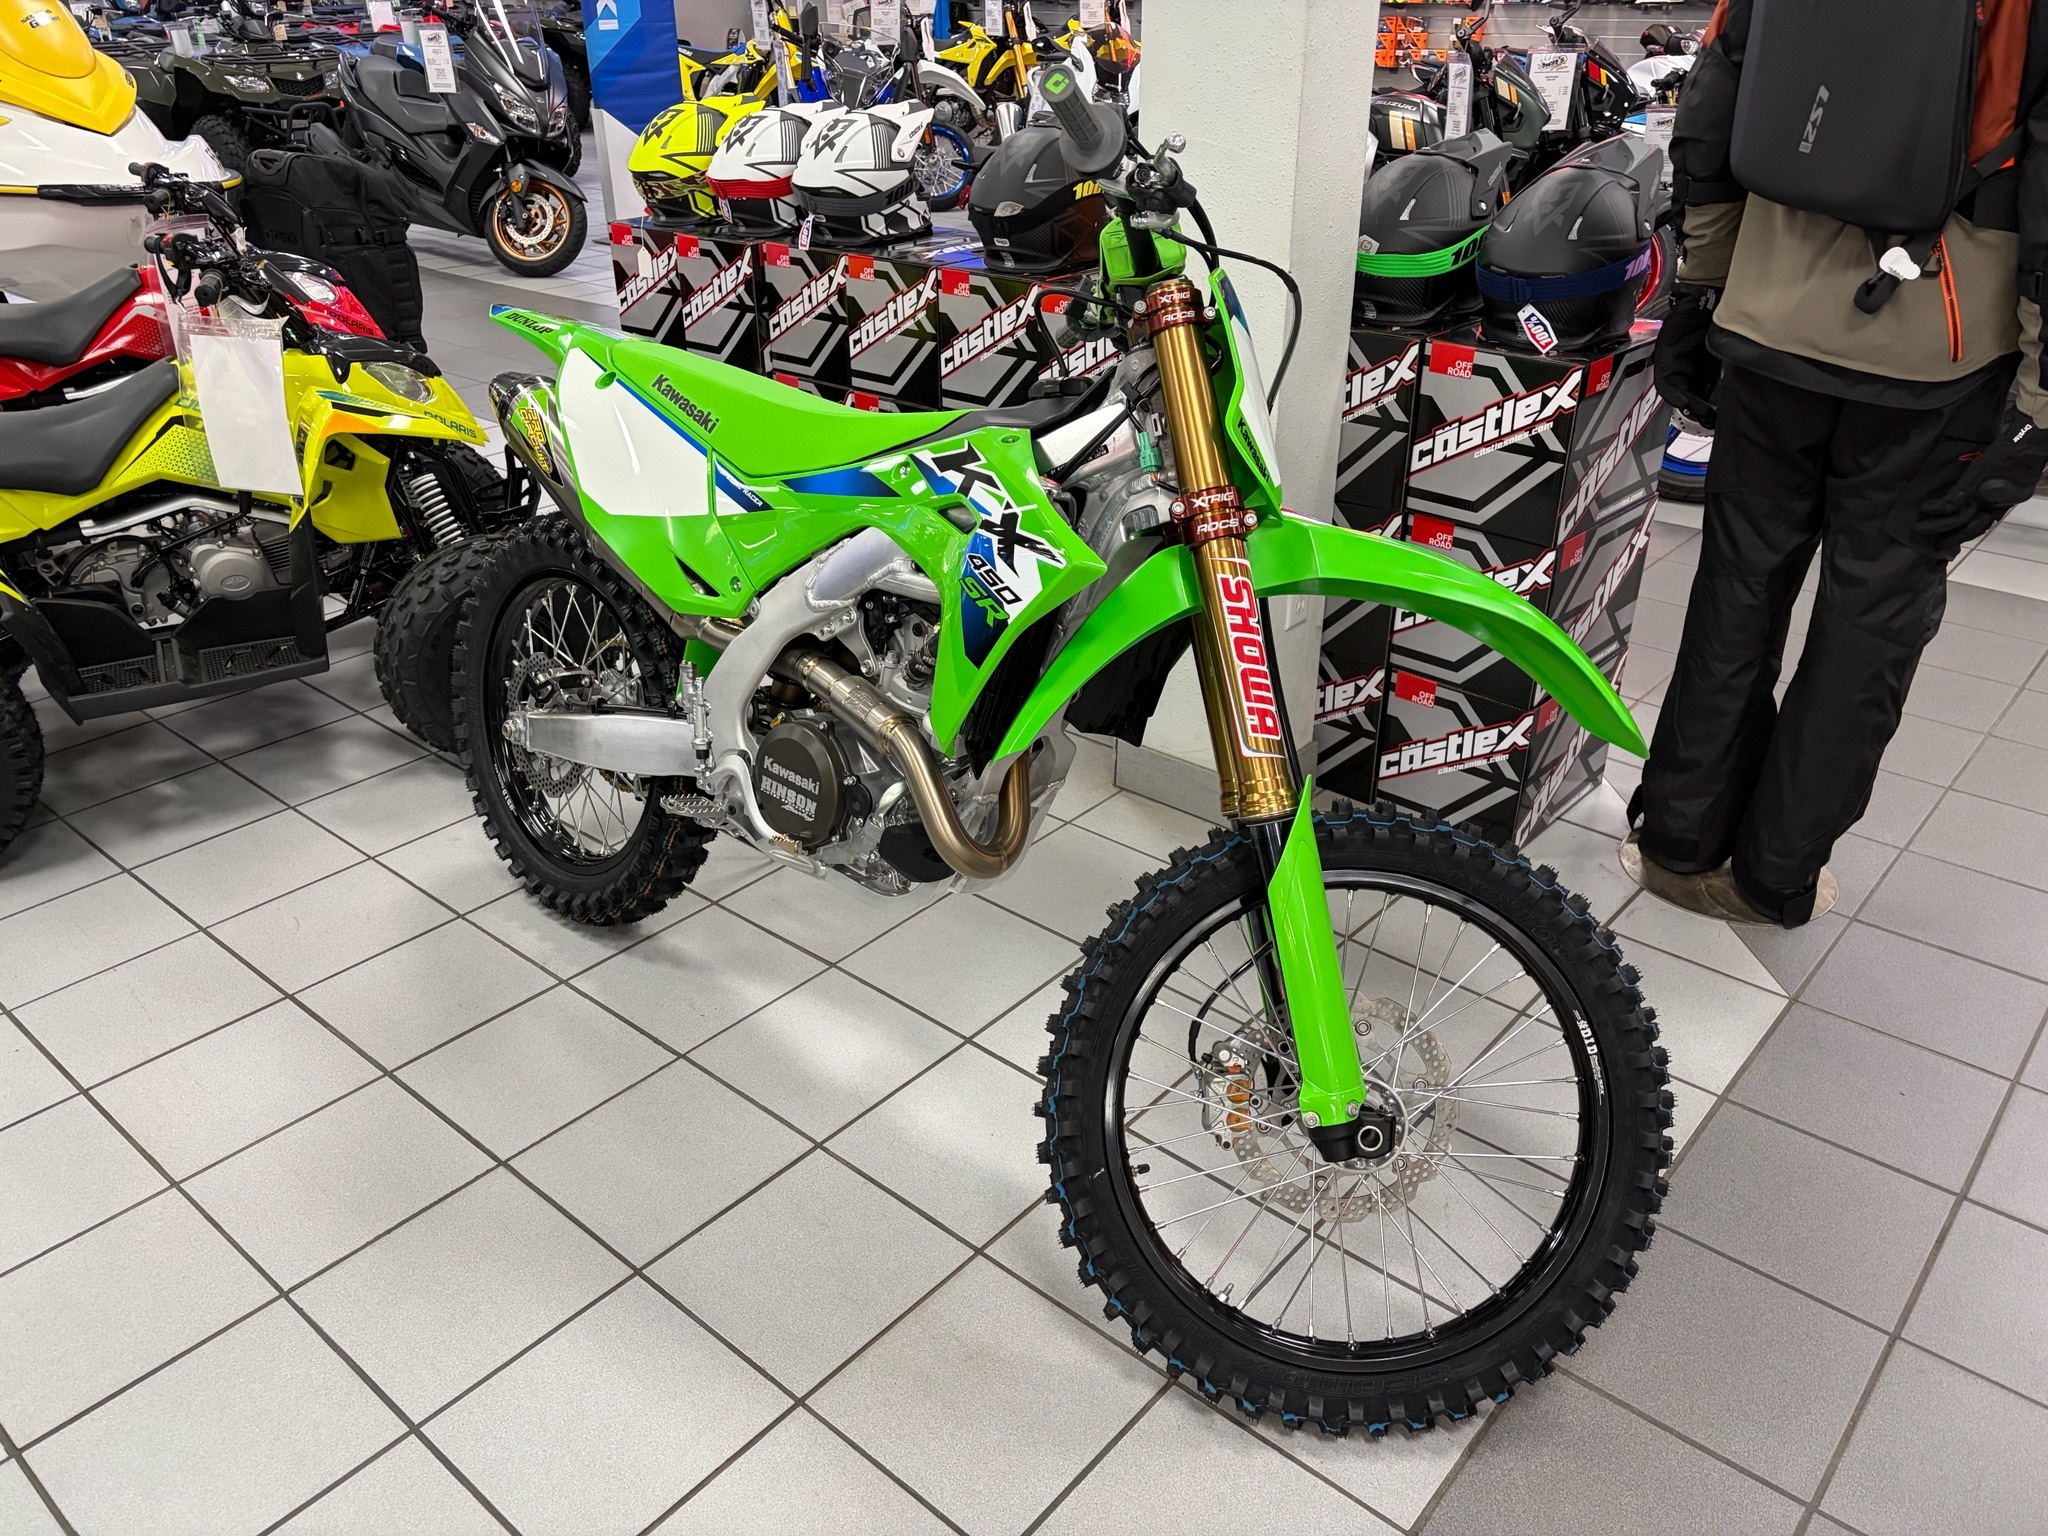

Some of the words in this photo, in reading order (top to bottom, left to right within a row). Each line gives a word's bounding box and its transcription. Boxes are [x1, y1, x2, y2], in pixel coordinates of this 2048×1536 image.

[1375, 101, 1417, 112] SUZUKI
[690, 246, 700, 254] OFF
[777, 260, 790, 268] ROAD
[781, 254, 790, 262] OFF
[859, 273, 875, 281] ROAD
[863, 267, 874, 275] OFF
[954, 288, 970, 297] ROAD
[1158, 291, 1190, 304] XTRIG
[327, 310, 375, 337] POLARIS
[1162, 309, 1196, 324] ROCS
[504, 313, 554, 335] DUNLOP
[1455, 360, 1473, 370] OFF
[1447, 367, 1472, 379] ROAD
[1601, 371, 1611, 384] OFF
[1596, 379, 1610, 393] ROAD
[651, 373, 720, 435] Kawasaki
[424, 410, 477, 439] POLARIS
[1237, 416, 1271, 483] Kawasaki
[742, 489, 764, 507] RACER
[1190, 491, 1234, 509] XTRIG
[931, 441, 1064, 579] KX
[1196, 518, 1240, 535] ROCS
[1428, 537, 1452, 550] ROAD
[1436, 532, 1453, 542] OFF
[967, 553, 1024, 605] 450
[959, 575, 1010, 629] SR
[1217, 574, 1281, 739] SHOWA
[1411, 696, 1435, 708] ROAD
[1419, 691, 1435, 700] OFF
[763, 755, 820, 796] Kawasaki
[760, 775, 817, 815] HINSON
